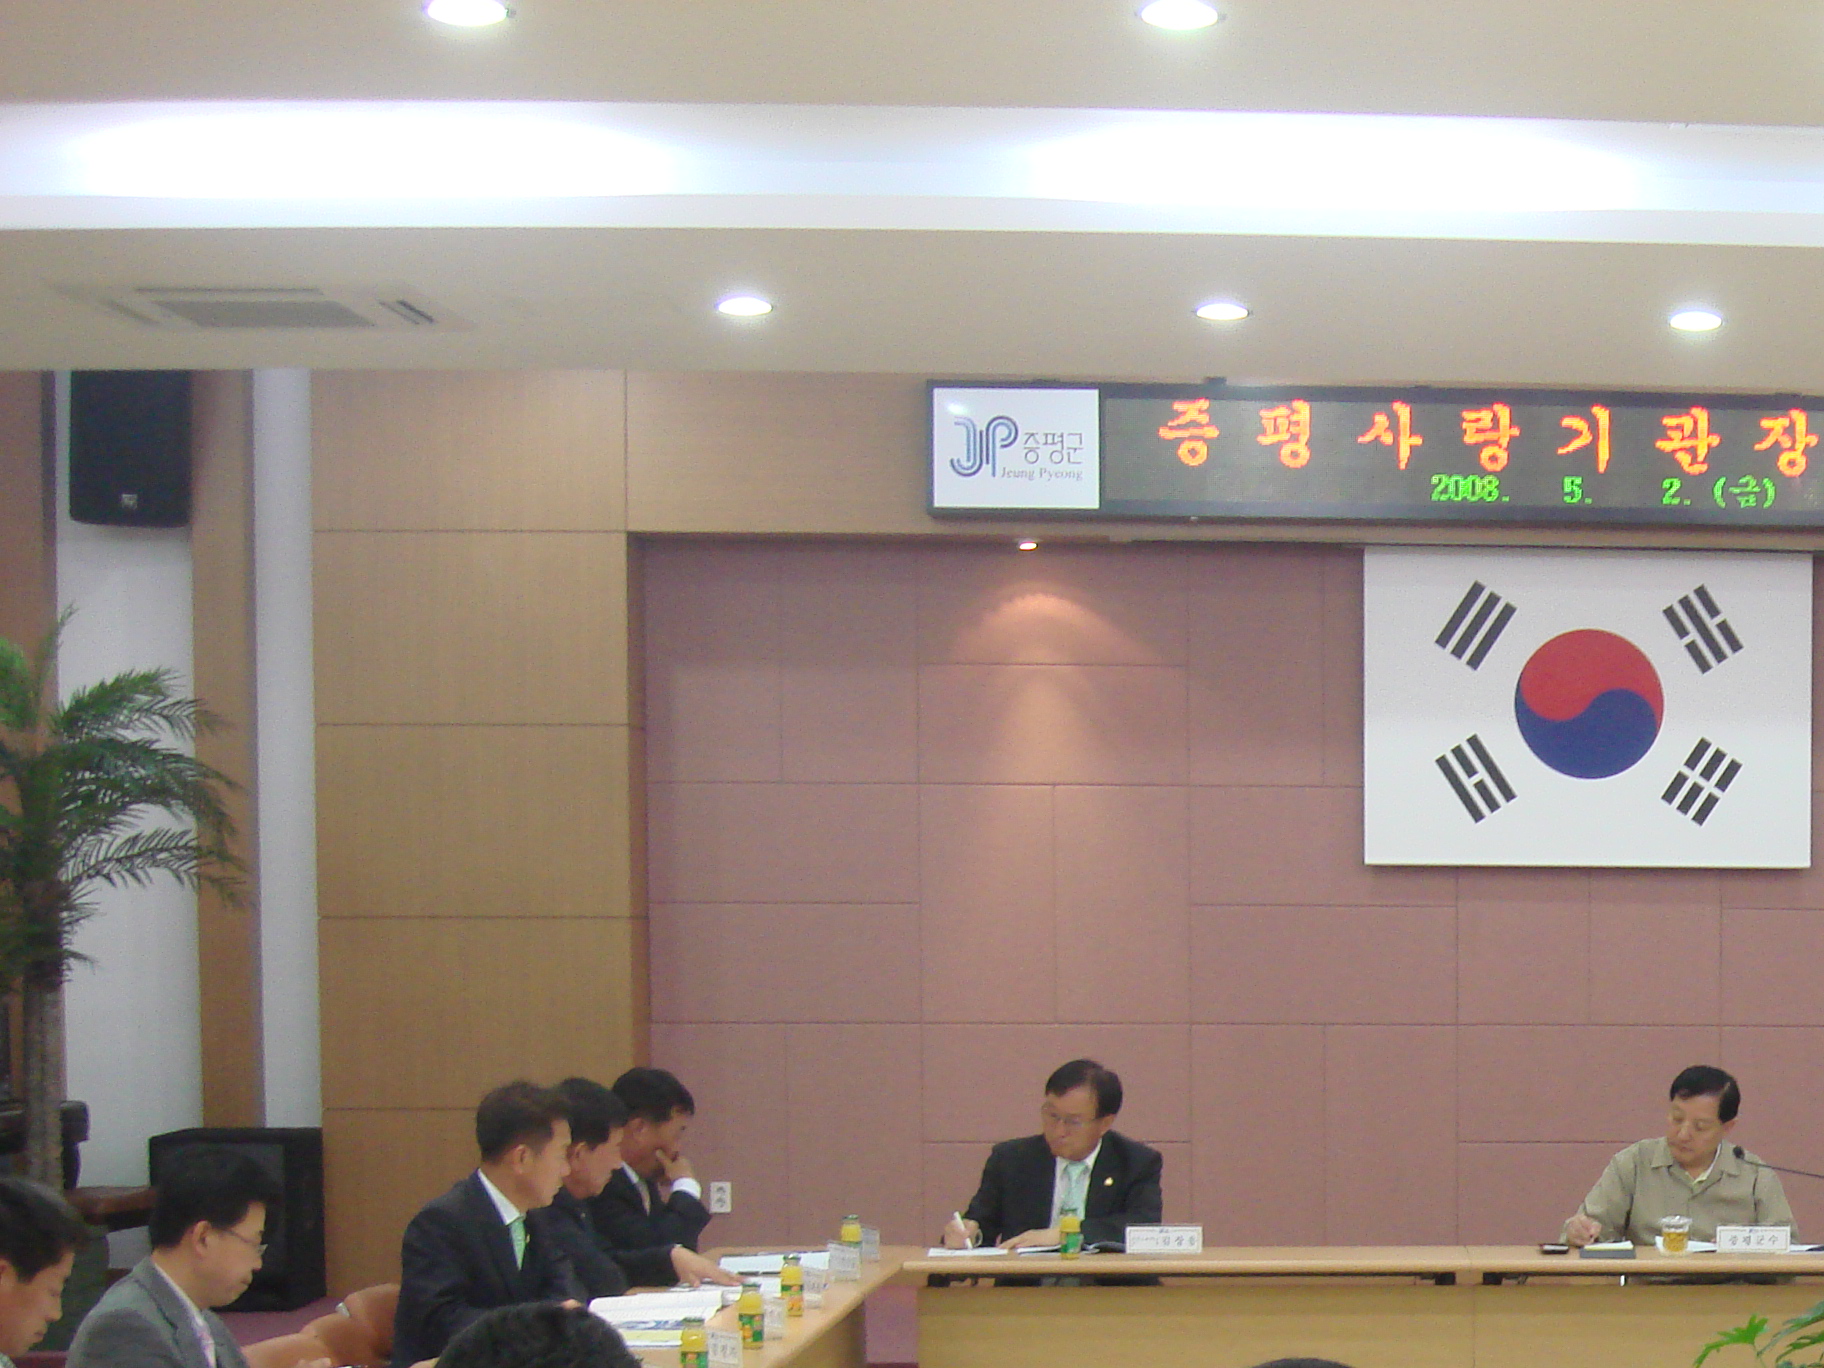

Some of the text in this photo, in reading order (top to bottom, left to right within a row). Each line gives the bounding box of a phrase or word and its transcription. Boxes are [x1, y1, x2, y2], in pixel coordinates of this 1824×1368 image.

[1023, 432, 1084, 464] 증평군
[1001, 467, 1084, 481] Jeung Pyeong
[1430, 473, 1510, 503] 2008.
[1561, 475, 1593, 505] 5.
